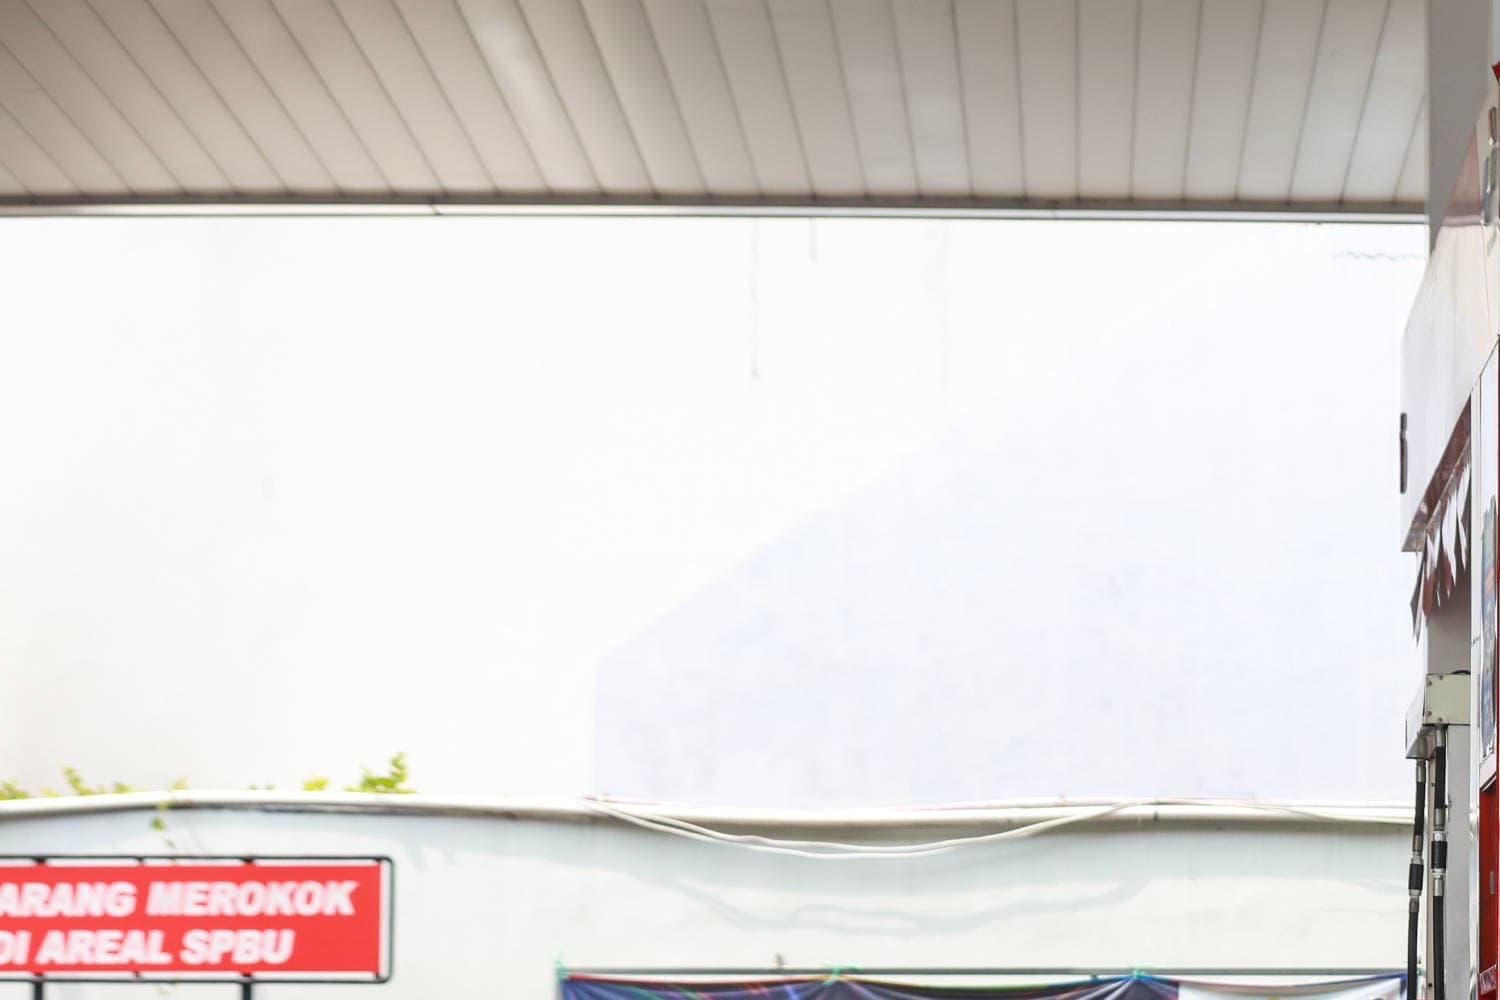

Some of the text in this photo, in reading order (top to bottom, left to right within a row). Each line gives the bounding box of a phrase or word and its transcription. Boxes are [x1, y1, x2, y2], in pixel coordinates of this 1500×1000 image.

[0, 881, 359, 917] ARANG MEROKOK
[34, 930, 173, 964] AREAL
[179, 929, 296, 964] SPBU
